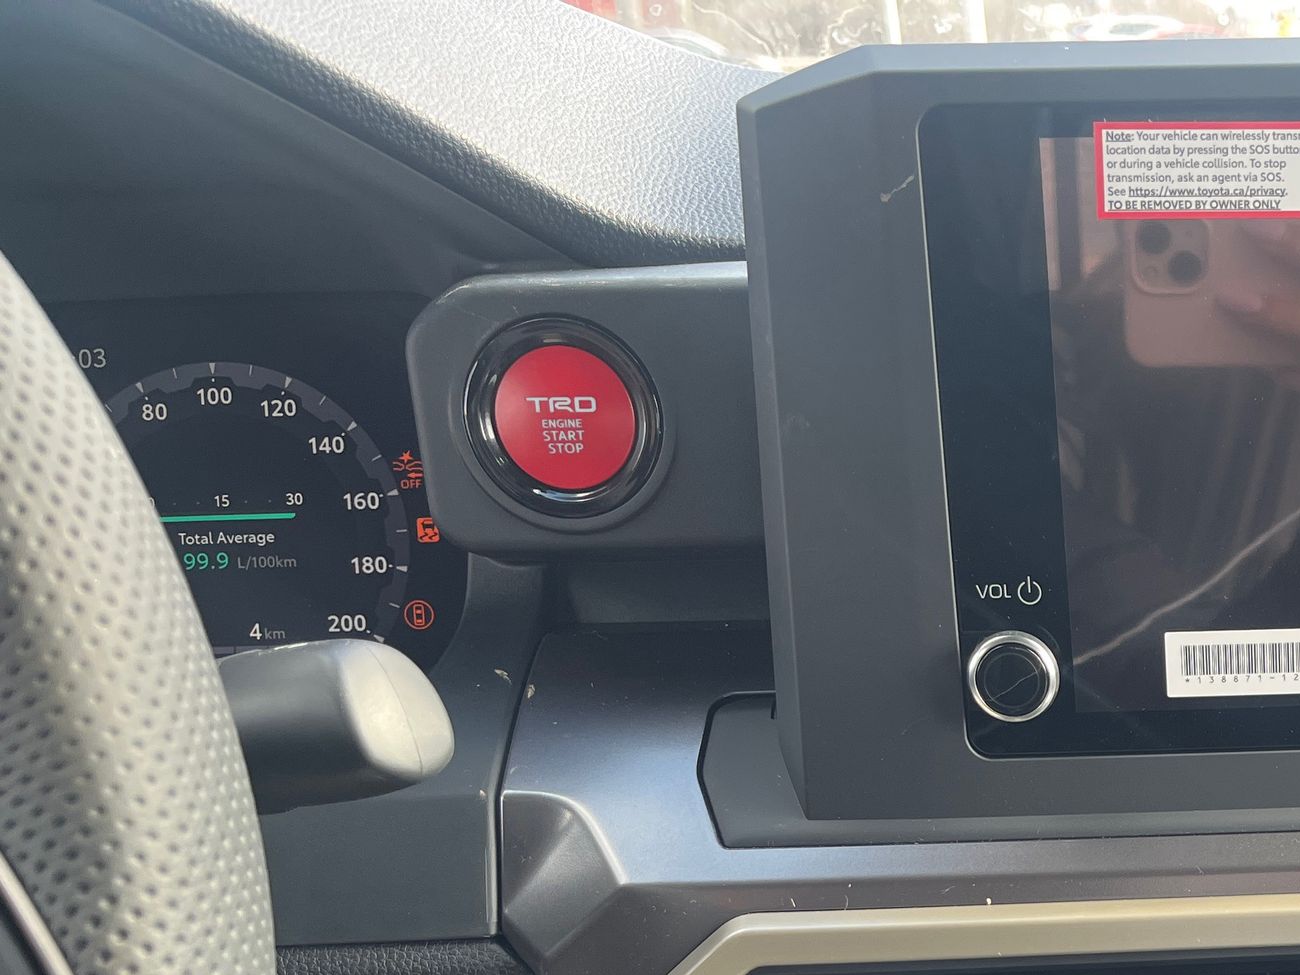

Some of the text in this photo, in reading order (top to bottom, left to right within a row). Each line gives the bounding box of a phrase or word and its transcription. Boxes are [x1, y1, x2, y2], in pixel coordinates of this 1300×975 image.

[1105, 131, 1135, 142] Note:
[1137, 131, 1161, 140] Your
[1162, 131, 1198, 140] vehicle
[1220, 131, 1270, 143] wirelessly
[1106, 145, 1146, 155] location
[1148, 145, 1170, 155] data
[1173, 145, 1185, 156] by
[1187, 145, 1228, 157] pressing
[1231, 144, 1247, 154] the
[1249, 144, 1270, 154] SOS
[1120, 158, 1153, 170] during
[1164, 158, 1200, 168] vehicle
[1202, 158, 1247, 168] collision.
[1250, 159, 1262, 168] To
[1264, 160, 1286, 170] stop
[1107, 172, 1285, 184] transmission, ask an agent via SOS.
[1108, 186, 1288, 198] See https://www.toyota.ca/privacy.
[1108, 200, 1281, 211] TO BE REMOVED BY OWNER ONLY
[196, 387, 233, 406] 100
[525, 396, 597, 413] TRD
[141, 403, 168, 421] 80
[260, 399, 297, 418] 120
[541, 418, 583, 429] ENGINE
[543, 430, 585, 442] START
[308, 435, 345, 454] 140
[548, 442, 584, 455] STOP
[400, 478, 423, 490] OFF
[214, 492, 304, 508] 15 30
[343, 492, 380, 510] 160
[178, 531, 276, 547] Total Average
[183, 551, 297, 571] 99.9 L/100km
[350, 556, 388, 574] 180
[975, 583, 1012, 599] VOL
[327, 614, 367, 633] 200
